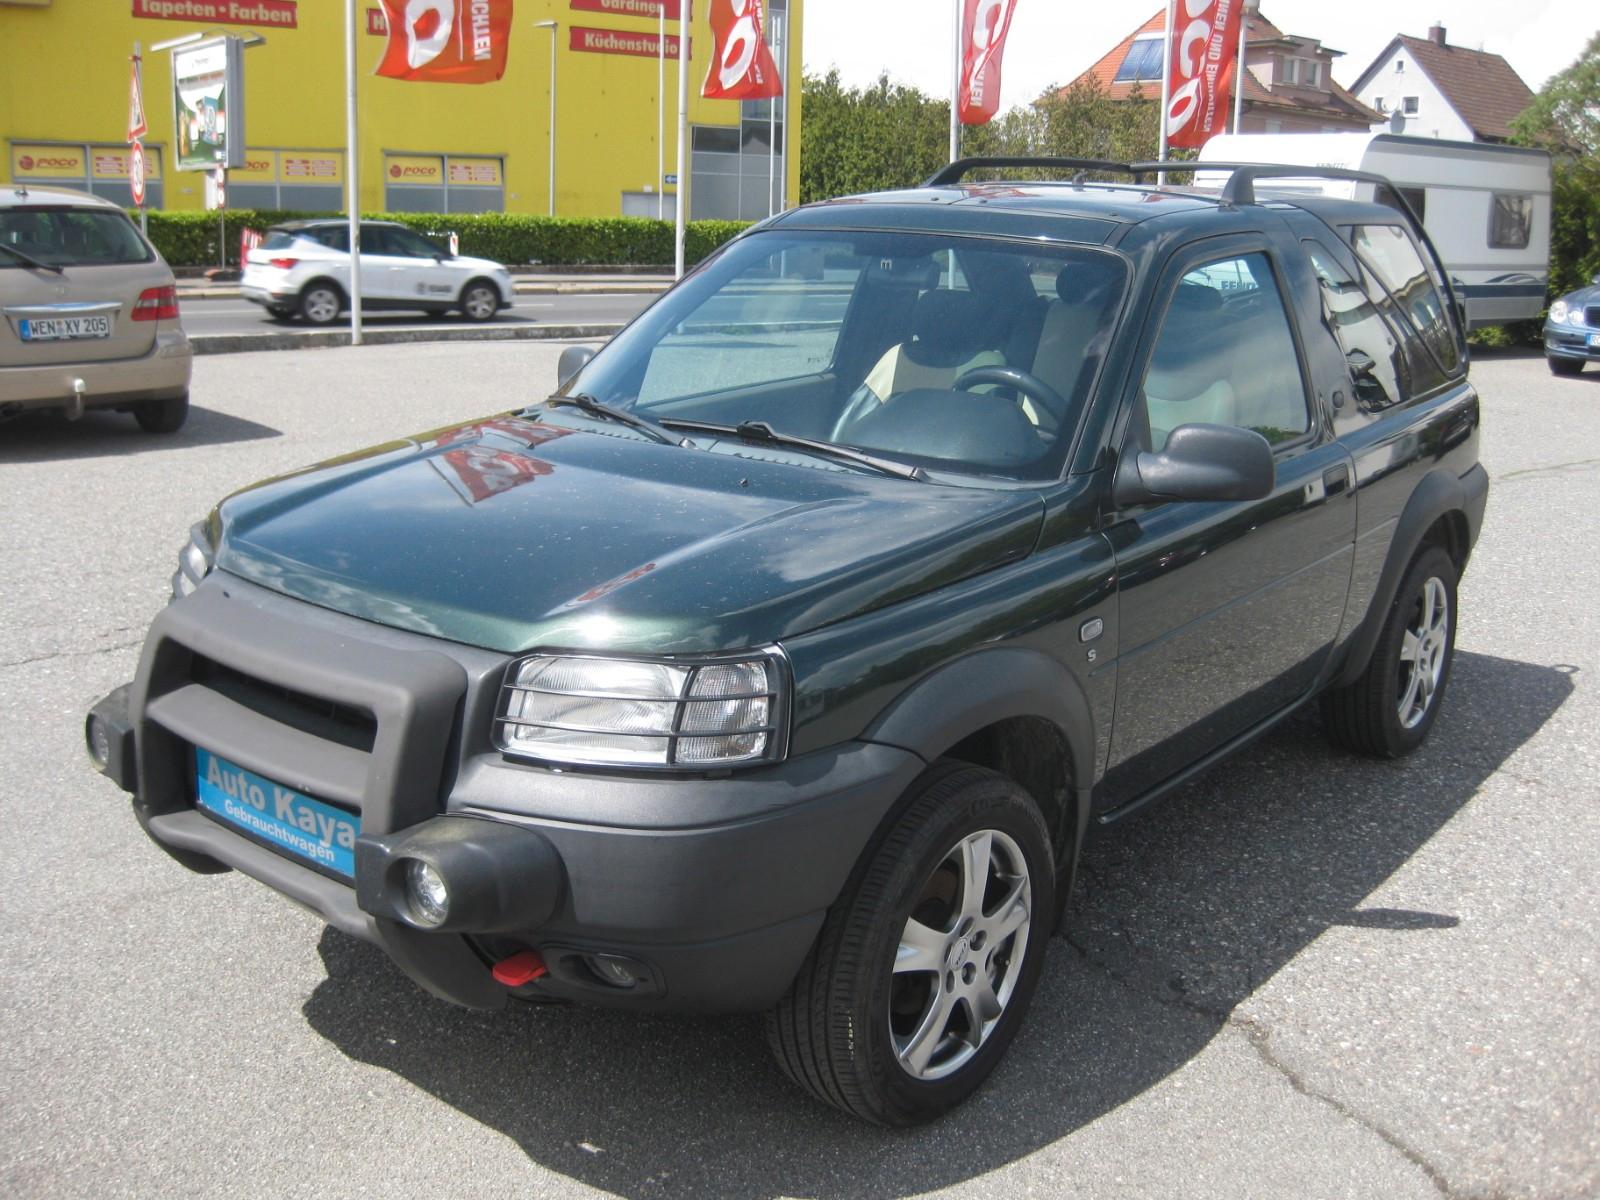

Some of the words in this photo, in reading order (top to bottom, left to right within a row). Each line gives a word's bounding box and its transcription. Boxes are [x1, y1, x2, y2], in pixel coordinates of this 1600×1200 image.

[141, 0, 216, 17] Tapeten
[229, 3, 293, 23] Farben
[246, 161, 270, 170] OCO
[30, 320, 57, 335] WEN
[64, 319, 80, 334] XY
[83, 318, 107, 332] 205
[207, 755, 266, 811] Auto
[274, 786, 355, 849] Kaya
[224, 800, 335, 862] Gebrauchtwagen
